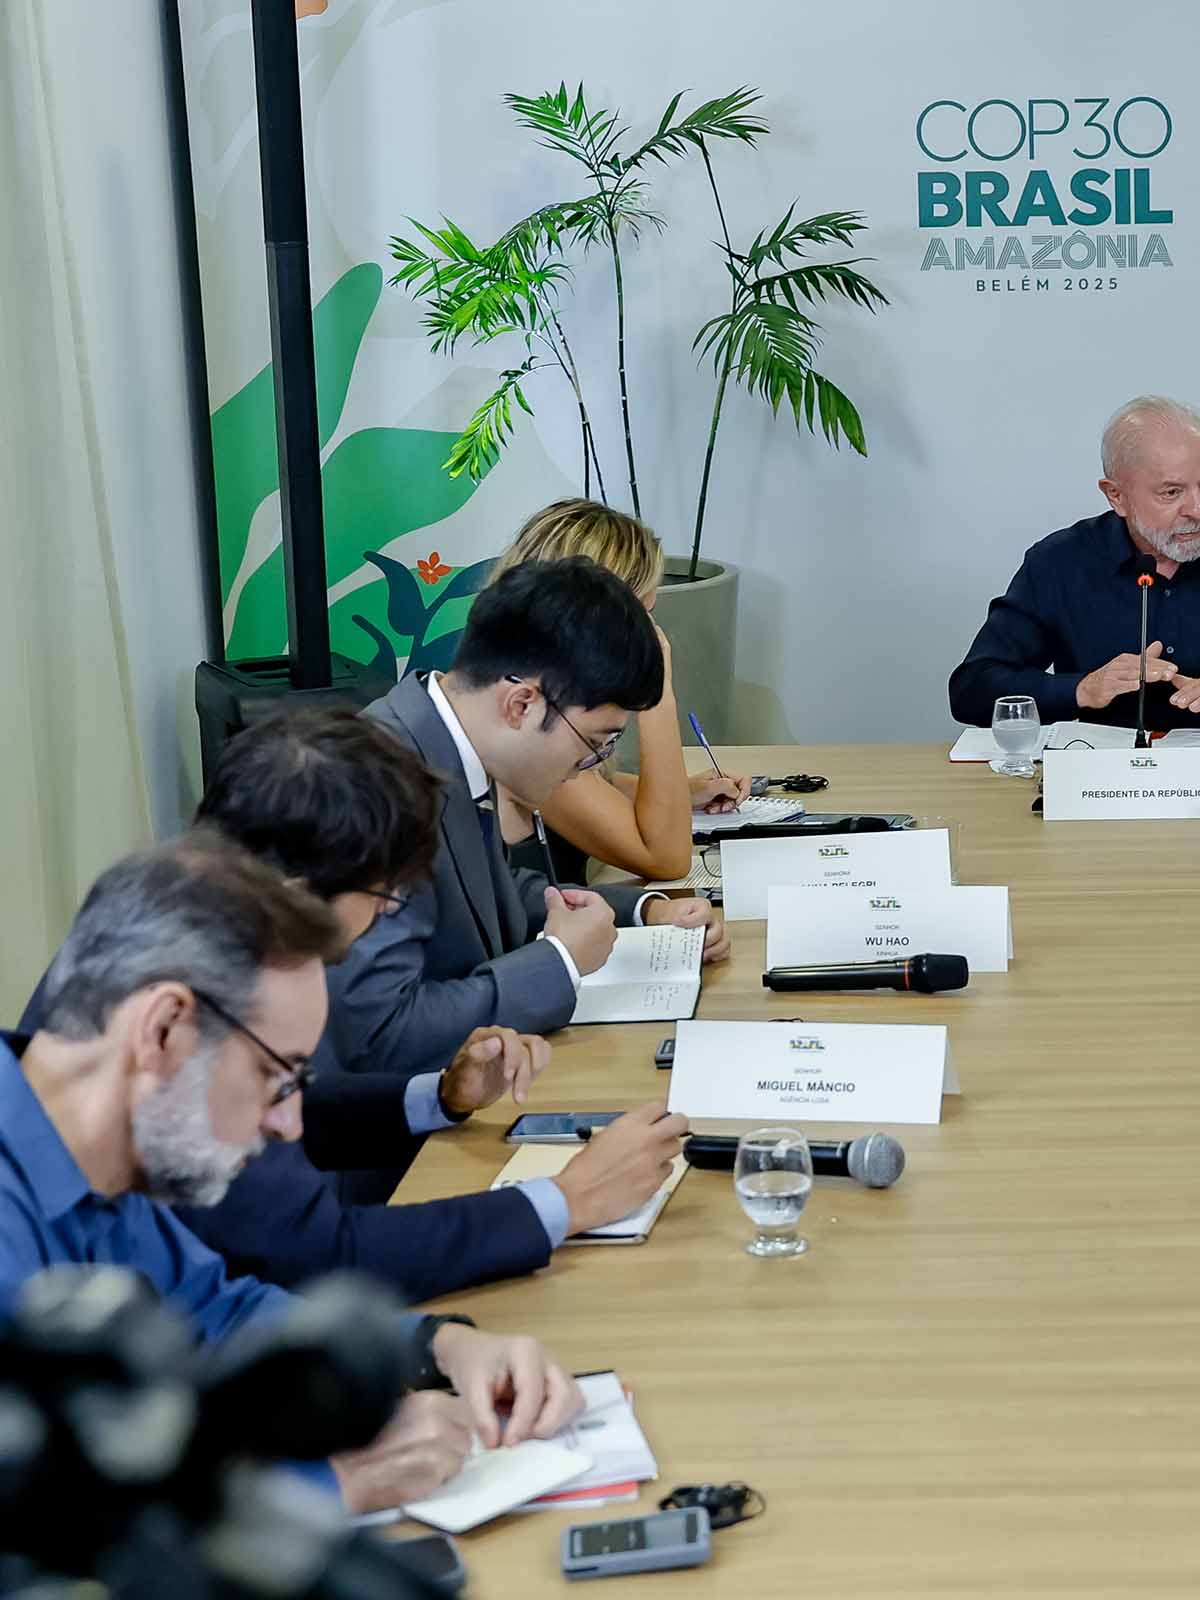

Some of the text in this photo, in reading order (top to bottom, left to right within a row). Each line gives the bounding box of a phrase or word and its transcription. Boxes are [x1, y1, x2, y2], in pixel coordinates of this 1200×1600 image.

[916, 96, 1173, 162] COP30
[917, 167, 1174, 227] BRASIL
[920, 230, 1174, 271] AMAZÔNIA
[976, 276, 1119, 292] BELÉM 2025
[1081, 790, 1140, 799] PRESIDENTE
[1142, 790, 1156, 798] DA
[865, 936, 910, 946] WU HAO
[756, 1081, 804, 1092] MIGUEL
